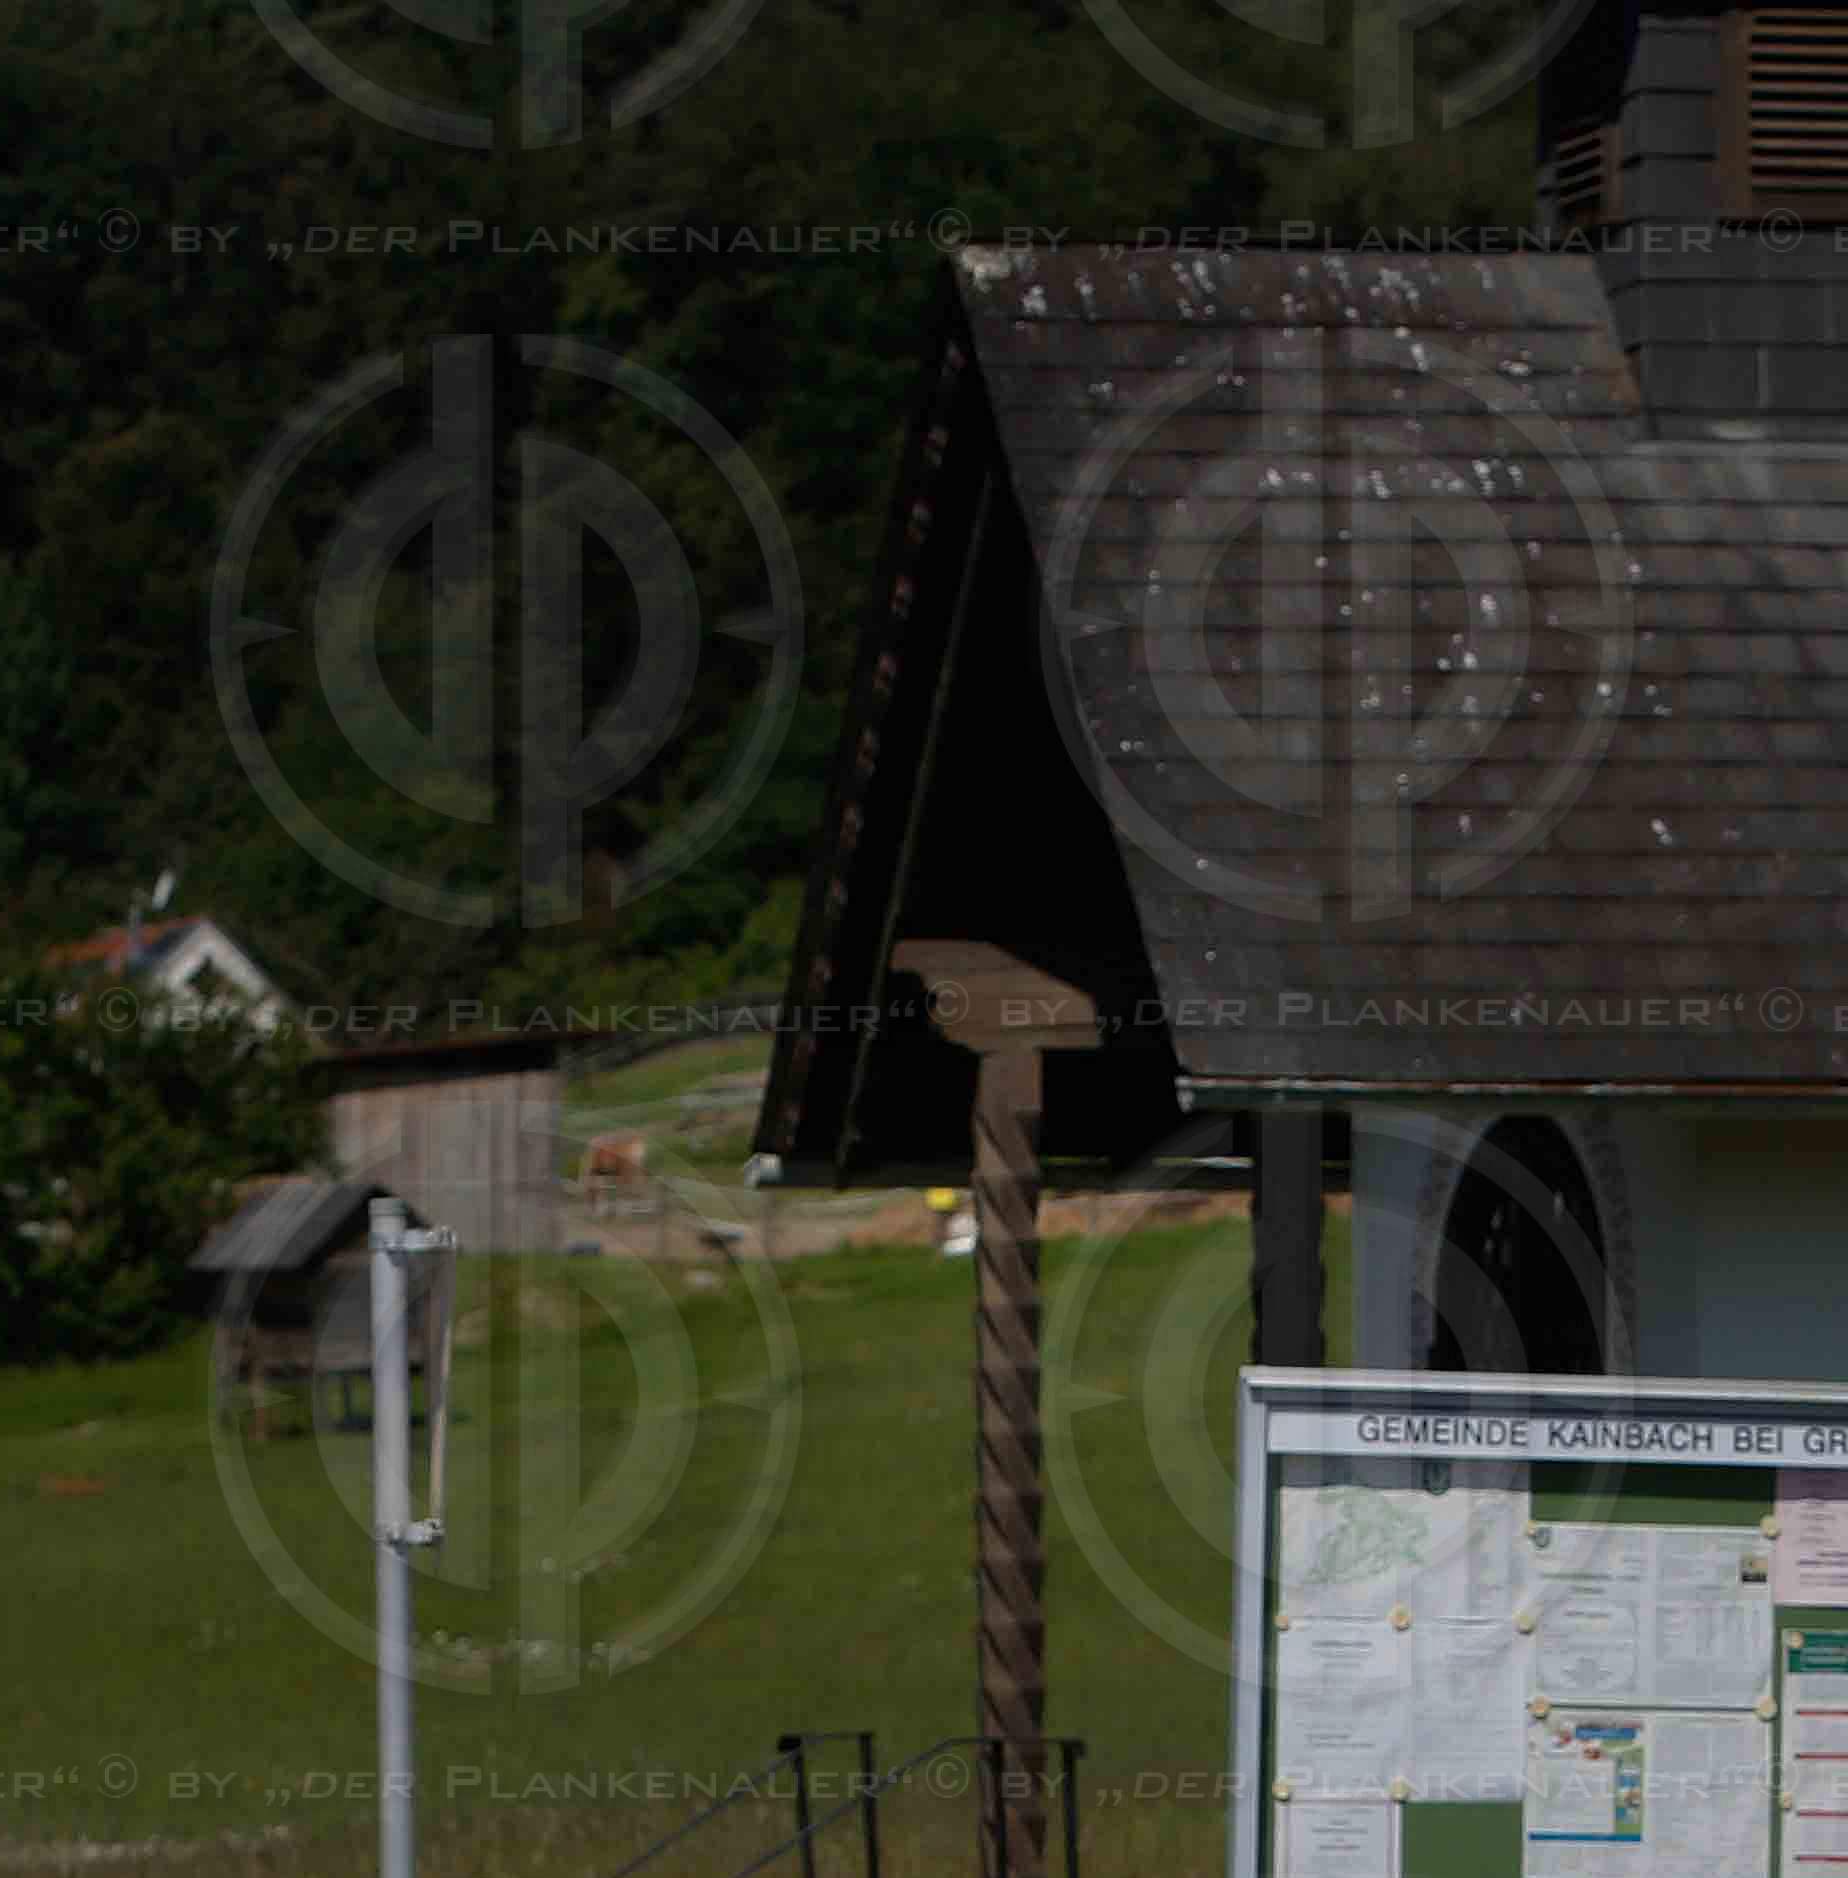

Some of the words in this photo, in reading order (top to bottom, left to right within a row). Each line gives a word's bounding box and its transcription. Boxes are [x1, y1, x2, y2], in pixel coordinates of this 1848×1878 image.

[1356, 1415, 1529, 1447] GEMEINDE
[1548, 1419, 1713, 1453] KAINBACH
[1733, 1424, 1784, 1454] BEI
